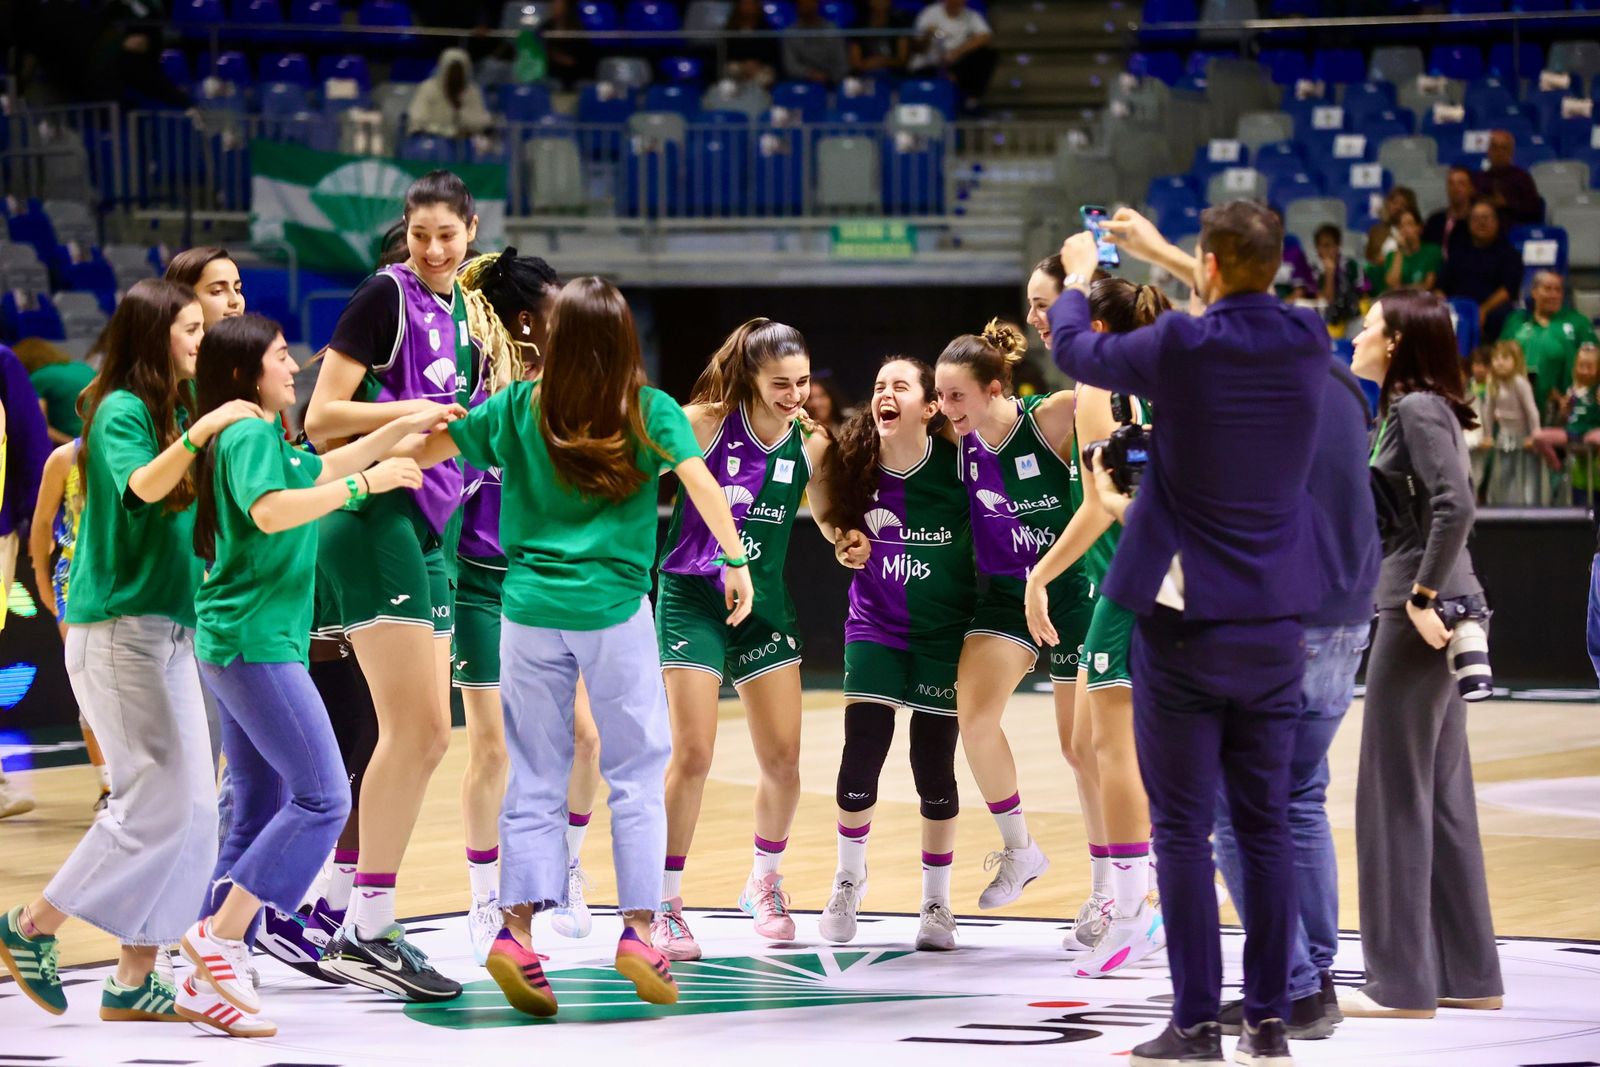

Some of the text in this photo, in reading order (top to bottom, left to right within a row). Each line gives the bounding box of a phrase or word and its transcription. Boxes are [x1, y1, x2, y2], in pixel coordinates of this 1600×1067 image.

[1005, 493, 1059, 513] Unicaja
[899, 526, 952, 543] Unicaja
[1011, 525, 1056, 554] Mijas
[882, 553, 931, 586] Mijas
